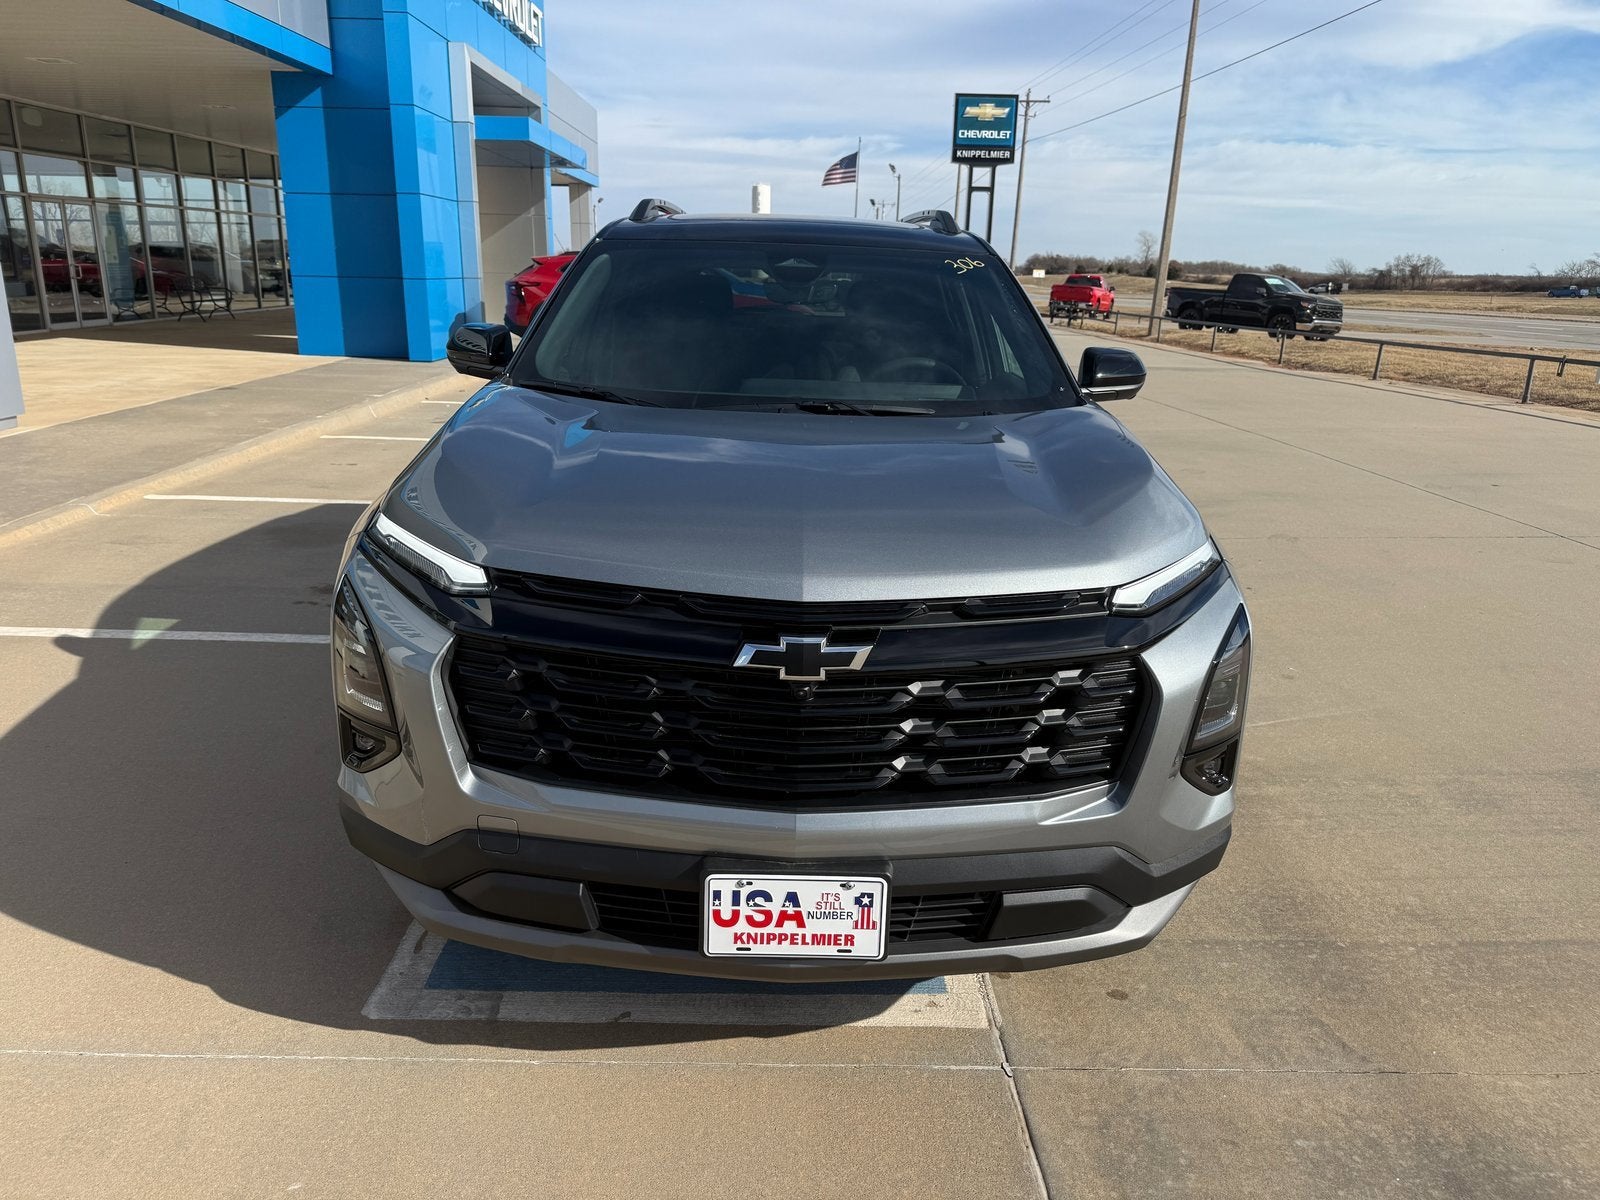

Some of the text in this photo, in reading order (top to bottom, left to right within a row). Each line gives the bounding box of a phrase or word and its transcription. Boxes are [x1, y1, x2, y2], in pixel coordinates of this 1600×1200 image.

[489, 0, 543, 47] ROLET
[958, 129, 1012, 139] CHEVROLET
[956, 149, 1011, 159] KNIPPELMIER
[944, 257, 985, 275] 306
[821, 892, 841, 901] IT'S
[712, 889, 806, 929] USA
[815, 901, 845, 911] STILL
[807, 910, 854, 920] NUMBER
[733, 931, 856, 947] KNIPPELMIER
